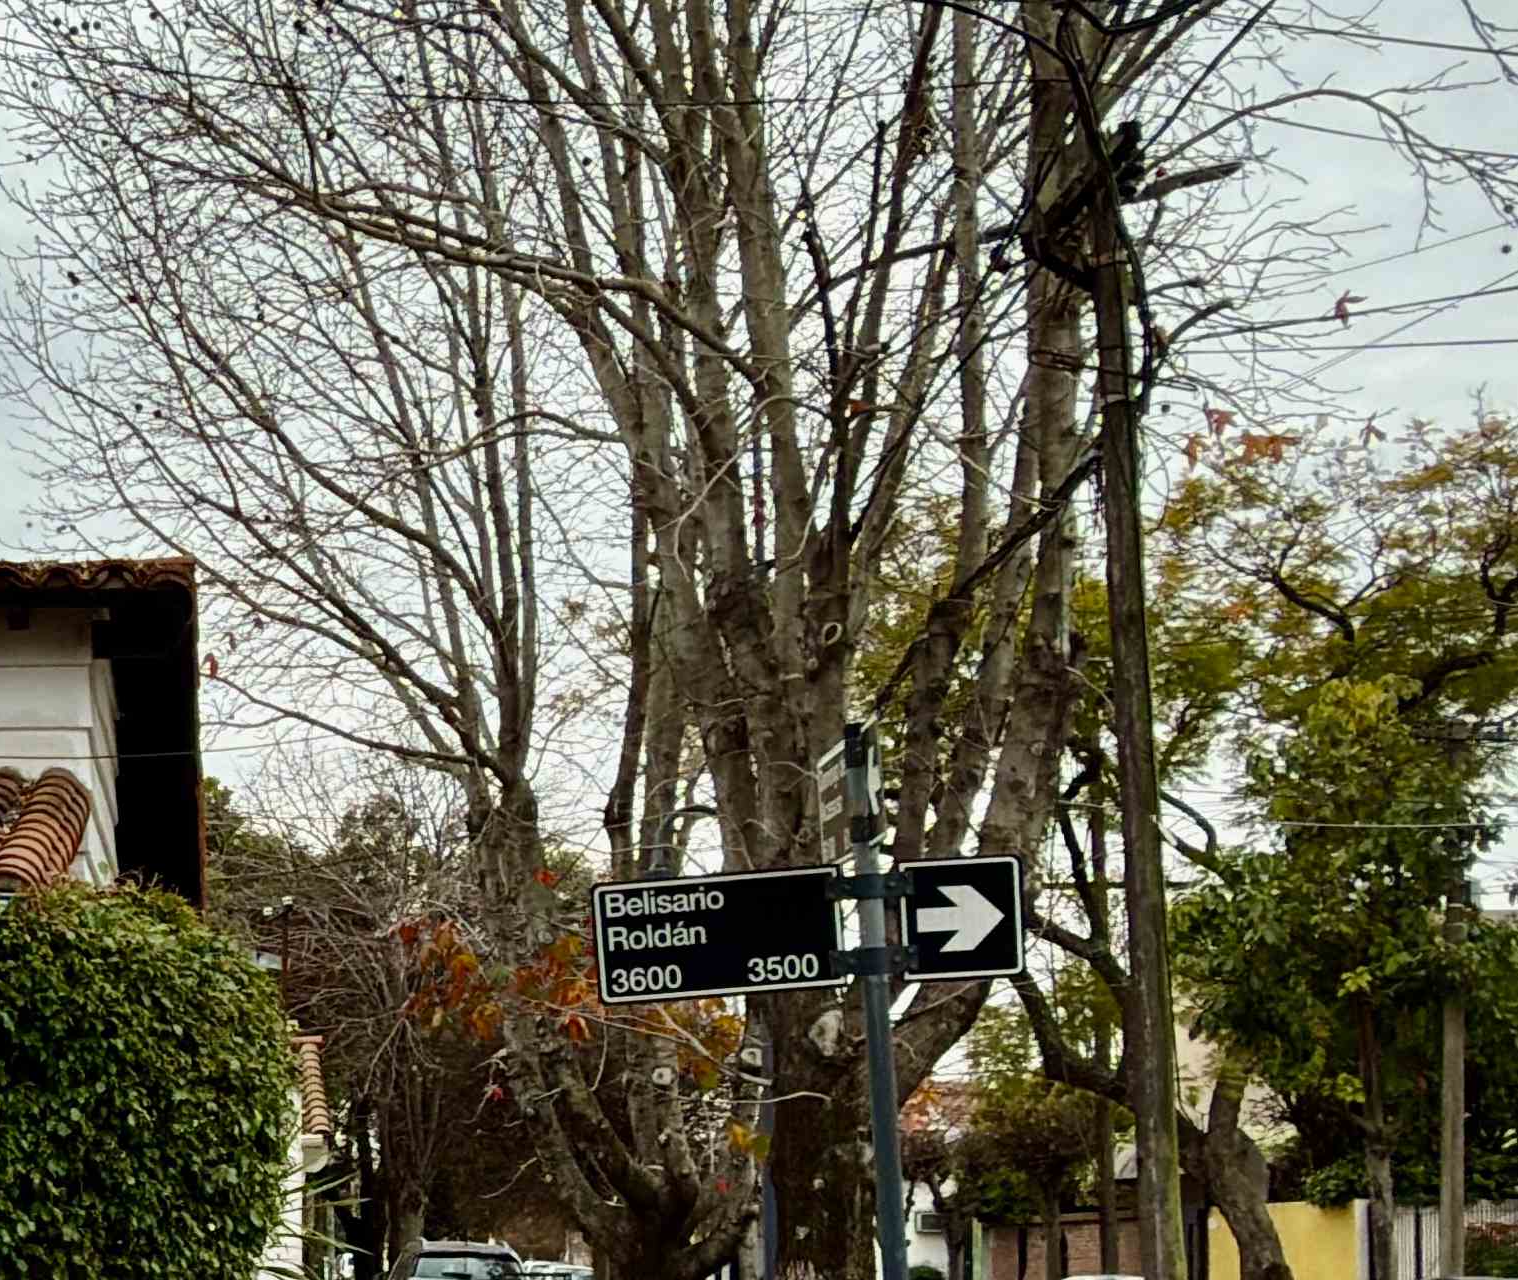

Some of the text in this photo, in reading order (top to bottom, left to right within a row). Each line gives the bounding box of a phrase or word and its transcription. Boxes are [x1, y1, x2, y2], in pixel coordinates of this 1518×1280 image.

[604, 886, 725, 919] Belisario
[606, 920, 708, 952] Roldán
[611, 953, 819, 994] 3600 3500
